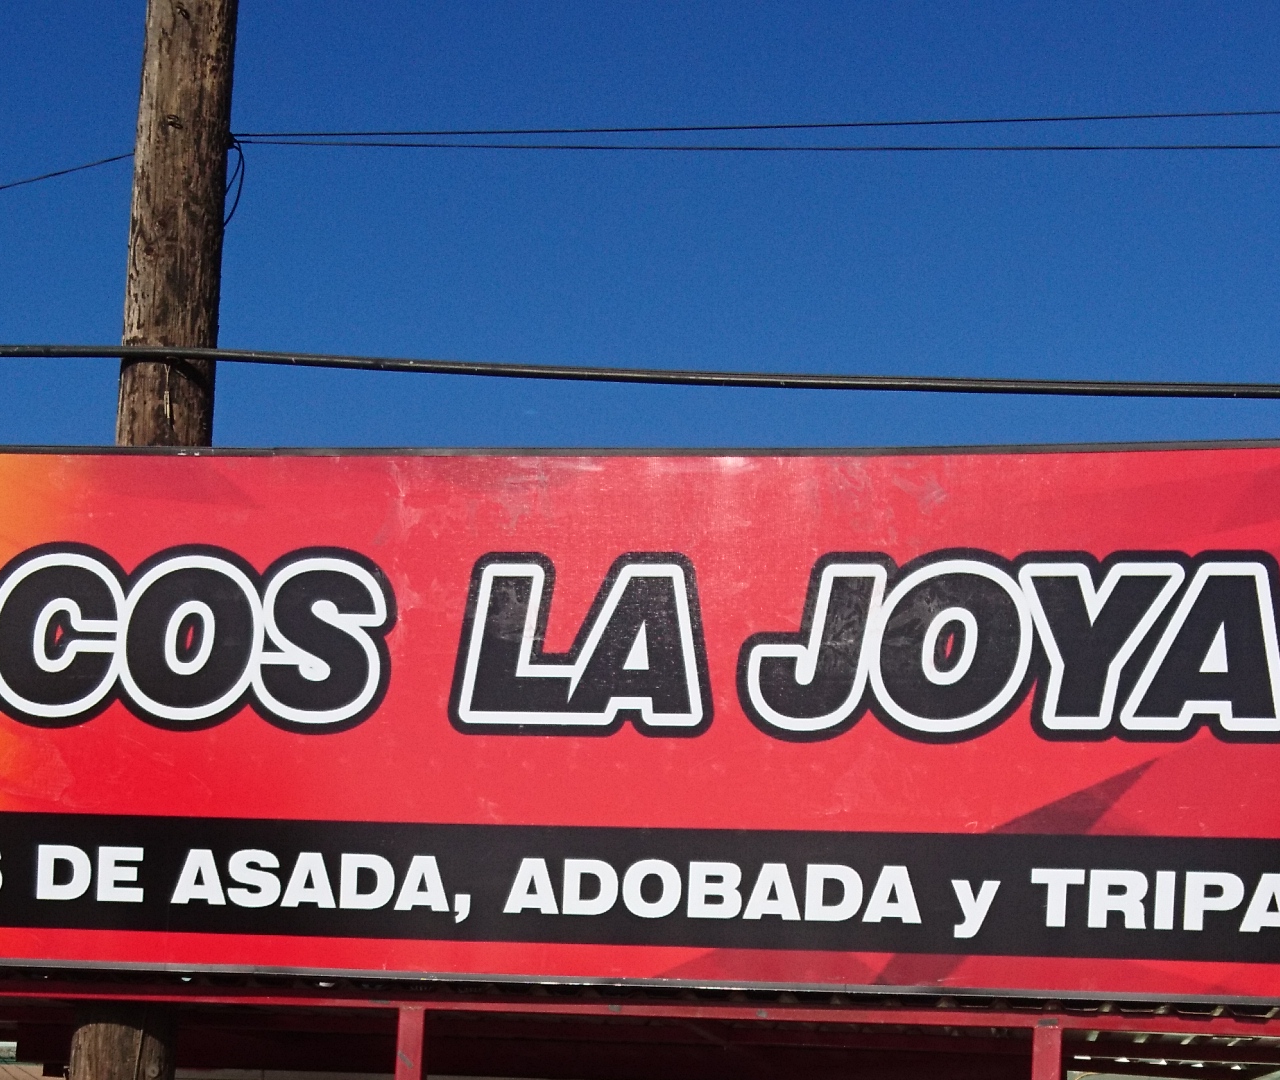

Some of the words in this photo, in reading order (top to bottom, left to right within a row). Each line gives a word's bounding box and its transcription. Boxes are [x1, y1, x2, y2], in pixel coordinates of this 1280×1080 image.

[452, 557, 709, 733] LA
[36, 843, 145, 903] DE
[170, 847, 472, 923] ASADA,
[503, 856, 923, 925] ADOBADA
[951, 879, 1002, 940] y
